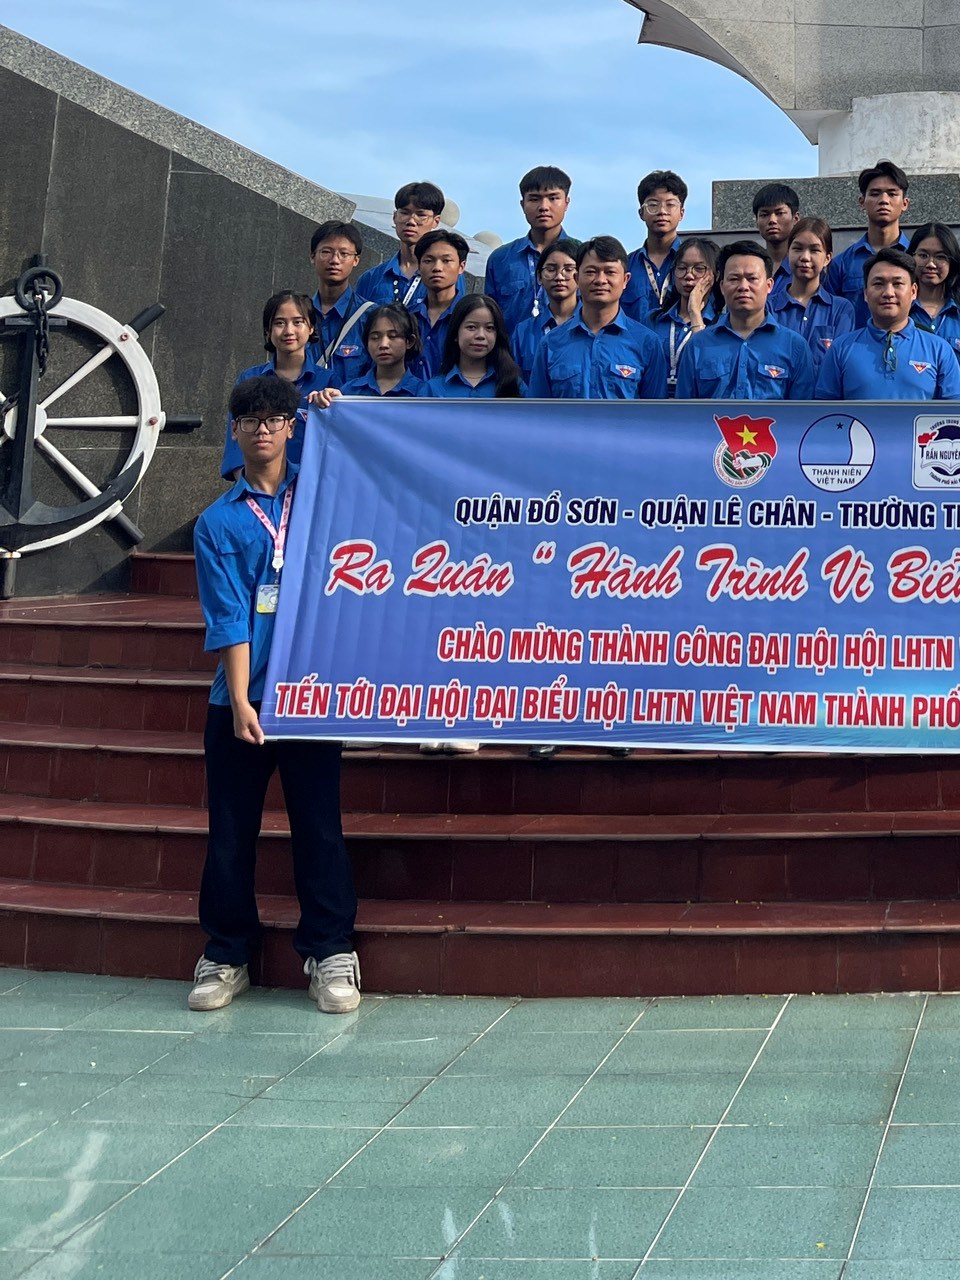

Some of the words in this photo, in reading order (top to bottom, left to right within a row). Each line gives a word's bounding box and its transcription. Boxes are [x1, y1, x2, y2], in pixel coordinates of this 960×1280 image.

[817, 476, 835, 485] VIỆT
[842, 467, 861, 476] NIÊN
[456, 497, 520, 528] QUẬN
[527, 490, 561, 524] ĐỒ
[566, 497, 617, 525] SƠN
[641, 496, 706, 530] QUẬN
[714, 494, 741, 526] LÊ
[749, 494, 815, 527] CHÂN
[840, 496, 935, 529] TRƯỜNG
[326, 540, 394, 596] Ra
[404, 540, 514, 596] Quân
[568, 541, 684, 599] Hành
[697, 543, 809, 602] Trình
[822, 545, 875, 604] Vì
[438, 622, 504, 663] CHÀO
[509, 622, 582, 663] MỪNG
[589, 624, 669, 666] THÀNH
[674, 624, 740, 666] CÔNG
[748, 632, 790, 674] ĐẠI
[797, 628, 837, 675] HỘI
[844, 628, 884, 675] HỘI
[892, 635, 953, 670] LHTN
[275, 674, 329, 719] TIẾN
[336, 677, 372, 719] TỚI
[379, 683, 422, 726] ĐẠI
[427, 679, 470, 728] HỘI
[475, 687, 517, 728] ĐẠI
[523, 675, 578, 721] BIỂU
[584, 683, 627, 730] HỘI
[633, 688, 694, 725] LHTN
[701, 685, 754, 733] VIỆT
[759, 692, 816, 728] NAM
[824, 687, 904, 730] THÀNH
